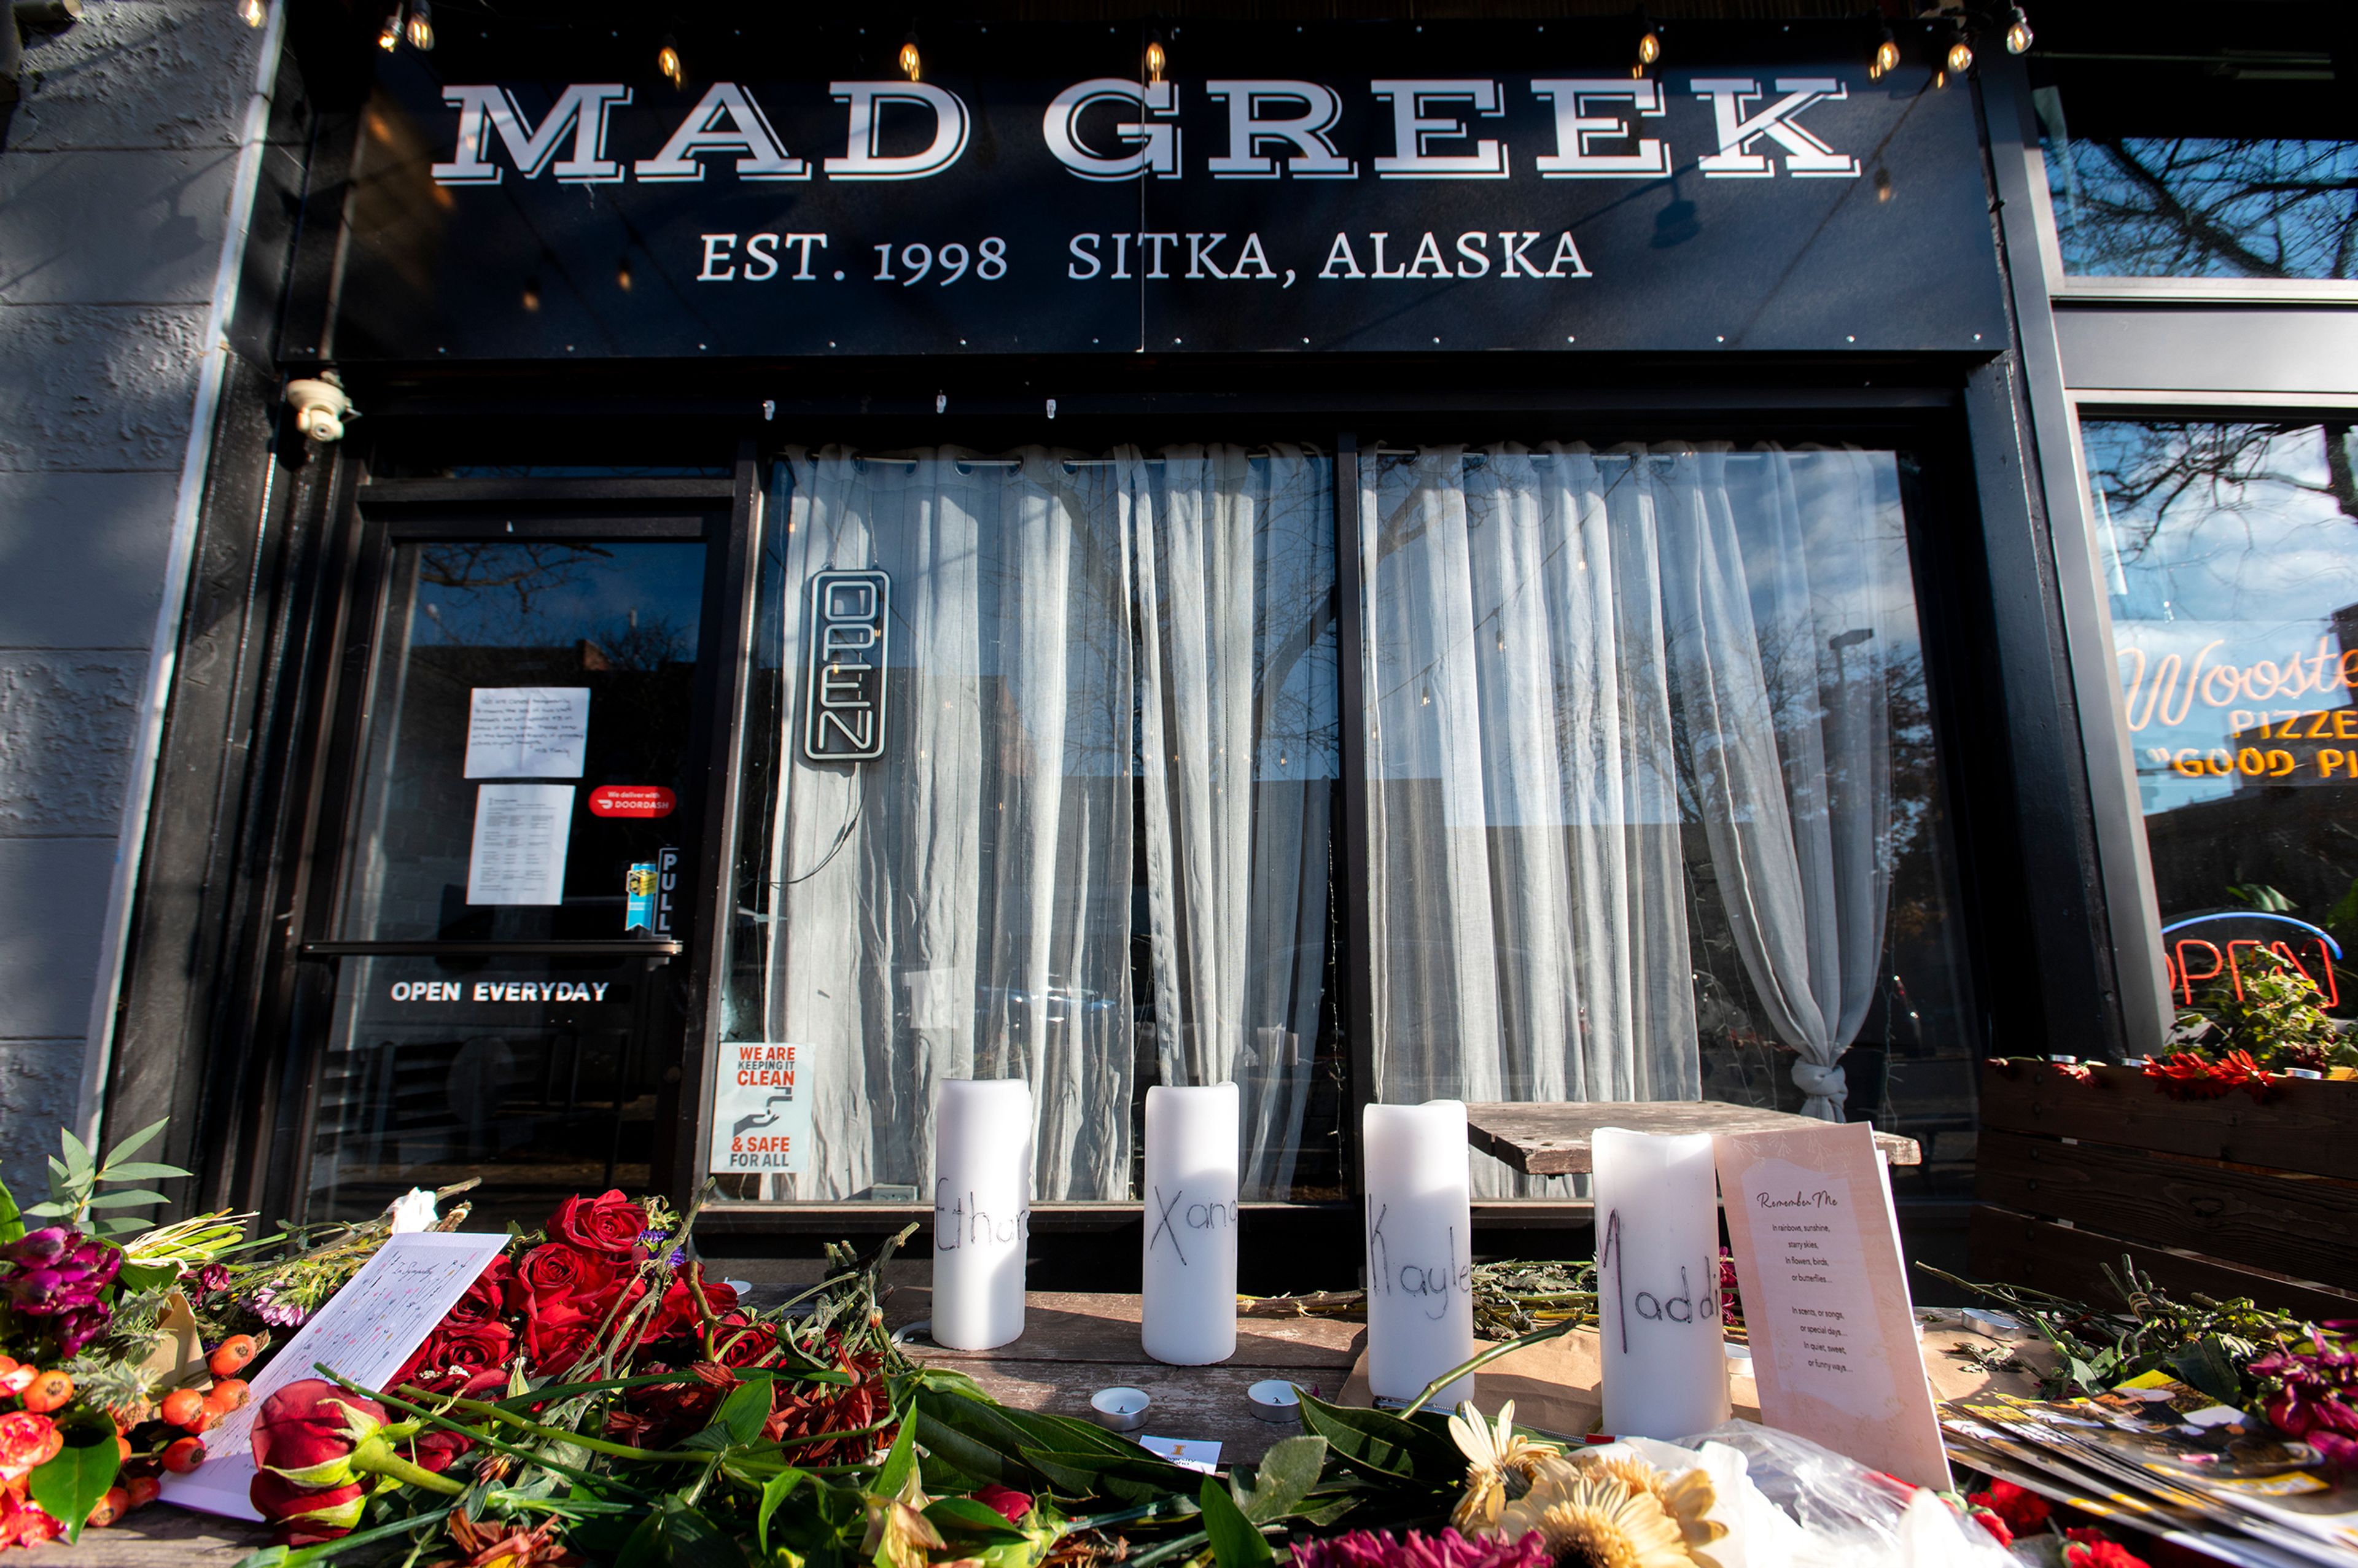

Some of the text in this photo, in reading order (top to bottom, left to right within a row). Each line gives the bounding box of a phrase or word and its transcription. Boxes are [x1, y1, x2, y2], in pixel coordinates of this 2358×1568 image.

[432, 77, 1862, 185] MAD GREEK
[697, 231, 1593, 289] EST. 1998 SITKA, ALASKA
[818, 581, 877, 750] OPEN
[615, 801, 669, 809] DOORDASH
[658, 853, 678, 931] PULL
[391, 982, 609, 1001] OPEN EVERYDAY
[739, 1047, 795, 1060] WE ARE
[737, 1060, 795, 1070] KEEPING IT
[736, 1070, 795, 1086] CLEAN
[731, 1136, 790, 1152] & SAFE
[730, 1154, 789, 1166] FOR ALL
[1756, 1190, 1838, 1208] Remember Me
[1804, 1224, 1830, 1232] sunshine,
[1788, 1241, 1803, 1250] starry
[1807, 1326, 1827, 1335] special
[1815, 1359, 1831, 1371] funny
